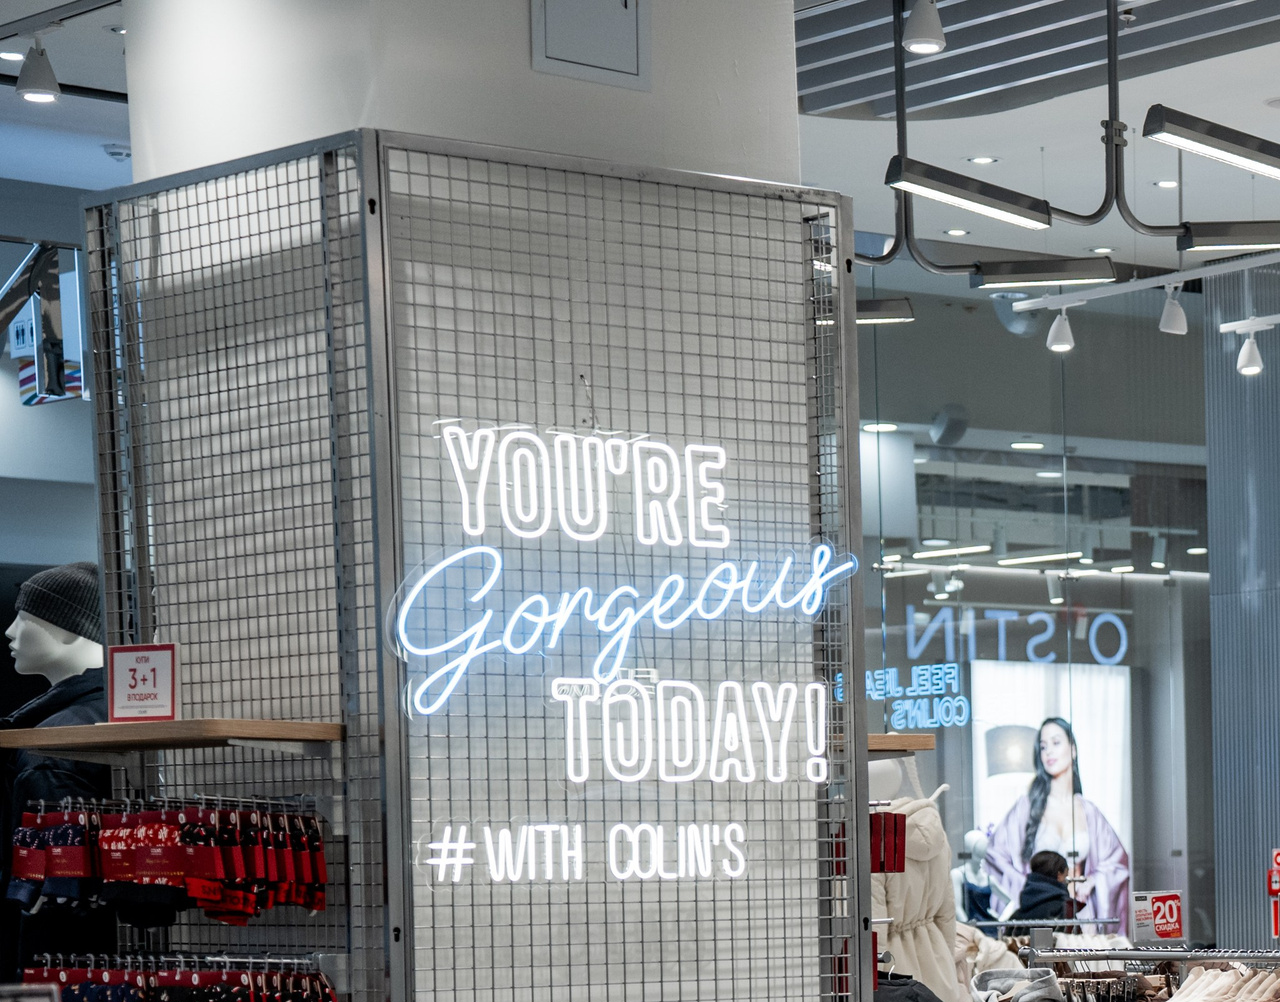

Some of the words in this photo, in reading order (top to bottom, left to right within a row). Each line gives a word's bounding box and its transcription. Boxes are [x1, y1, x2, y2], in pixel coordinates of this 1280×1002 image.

[443, 427, 731, 549] YOU'RE
[397, 545, 856, 715] Gorgeous
[551, 677, 829, 783] TODAY!
[608, 823, 747, 880] COLIN'S
[1153, 899, 1181, 924] 20%
